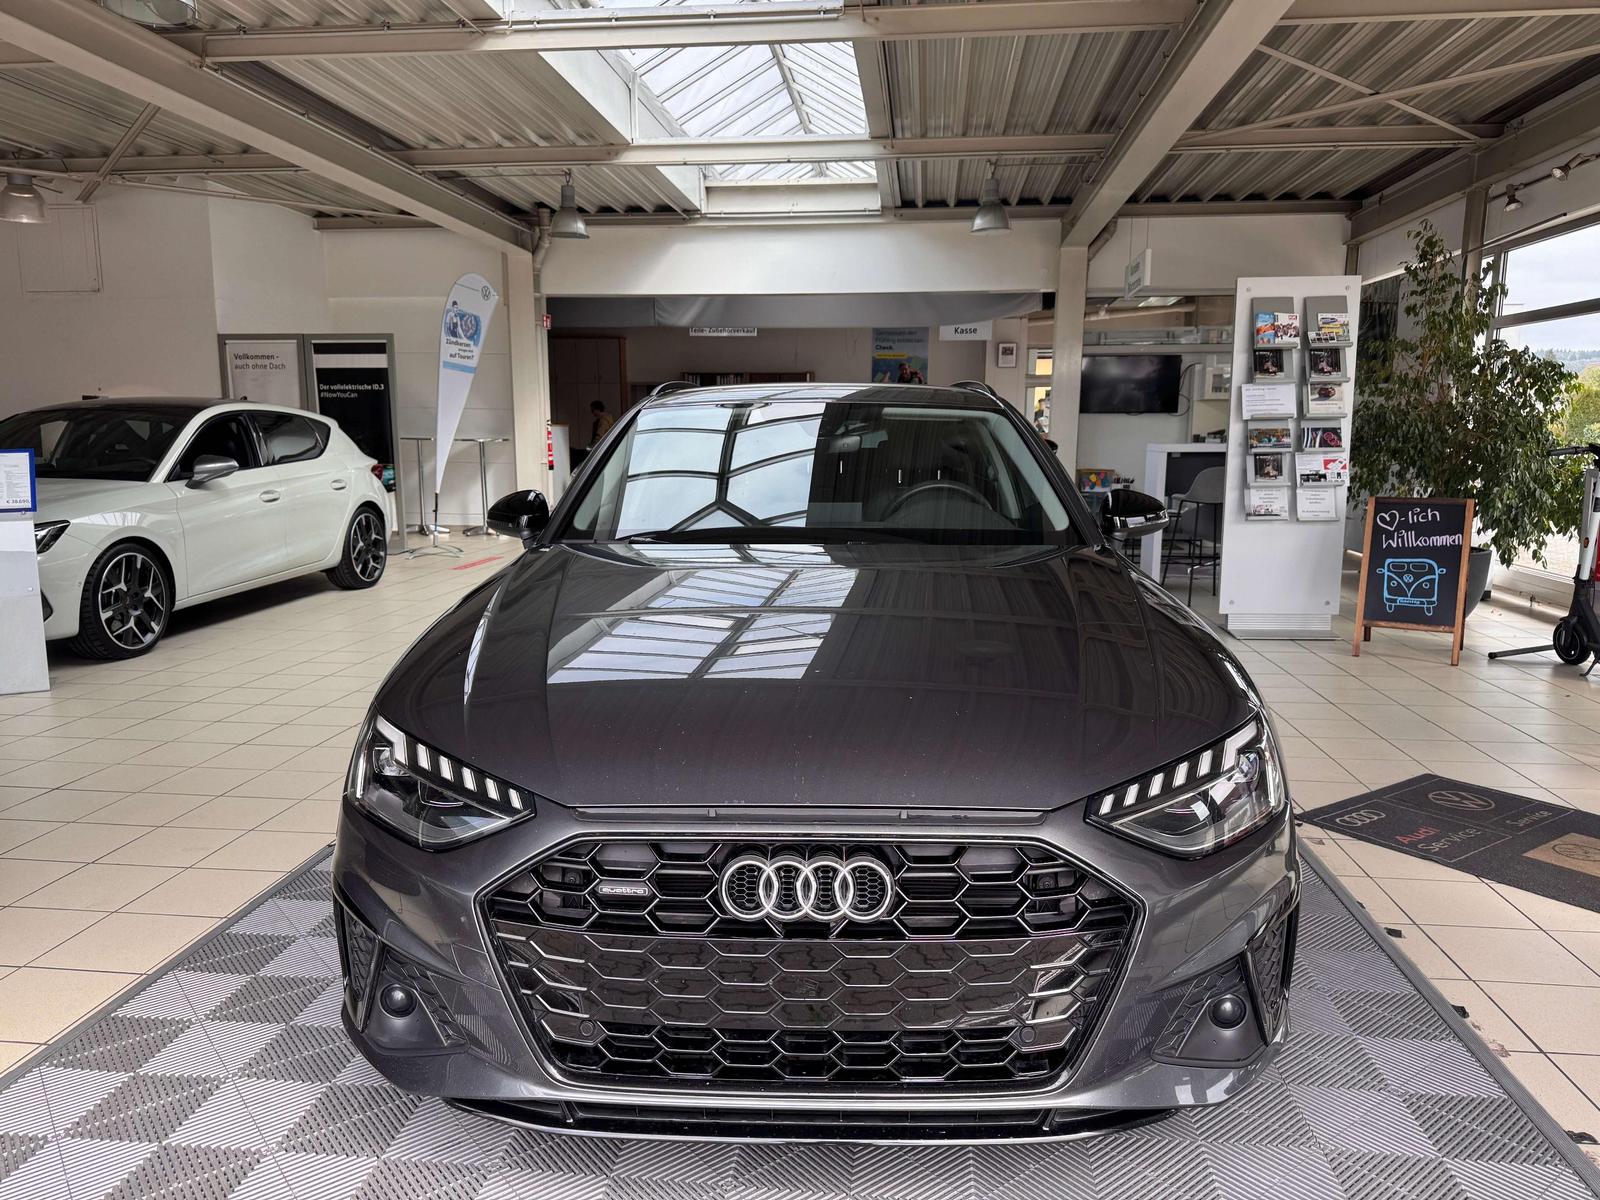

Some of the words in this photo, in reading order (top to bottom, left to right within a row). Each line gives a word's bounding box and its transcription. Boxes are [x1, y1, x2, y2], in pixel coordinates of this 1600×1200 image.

[954, 326, 978, 335] Kasse
[1382, 529, 1463, 549] Willkommen
[1506, 808, 1553, 828] Service
[1395, 825, 1440, 845] Audi
[1418, 826, 1484, 853] Service
